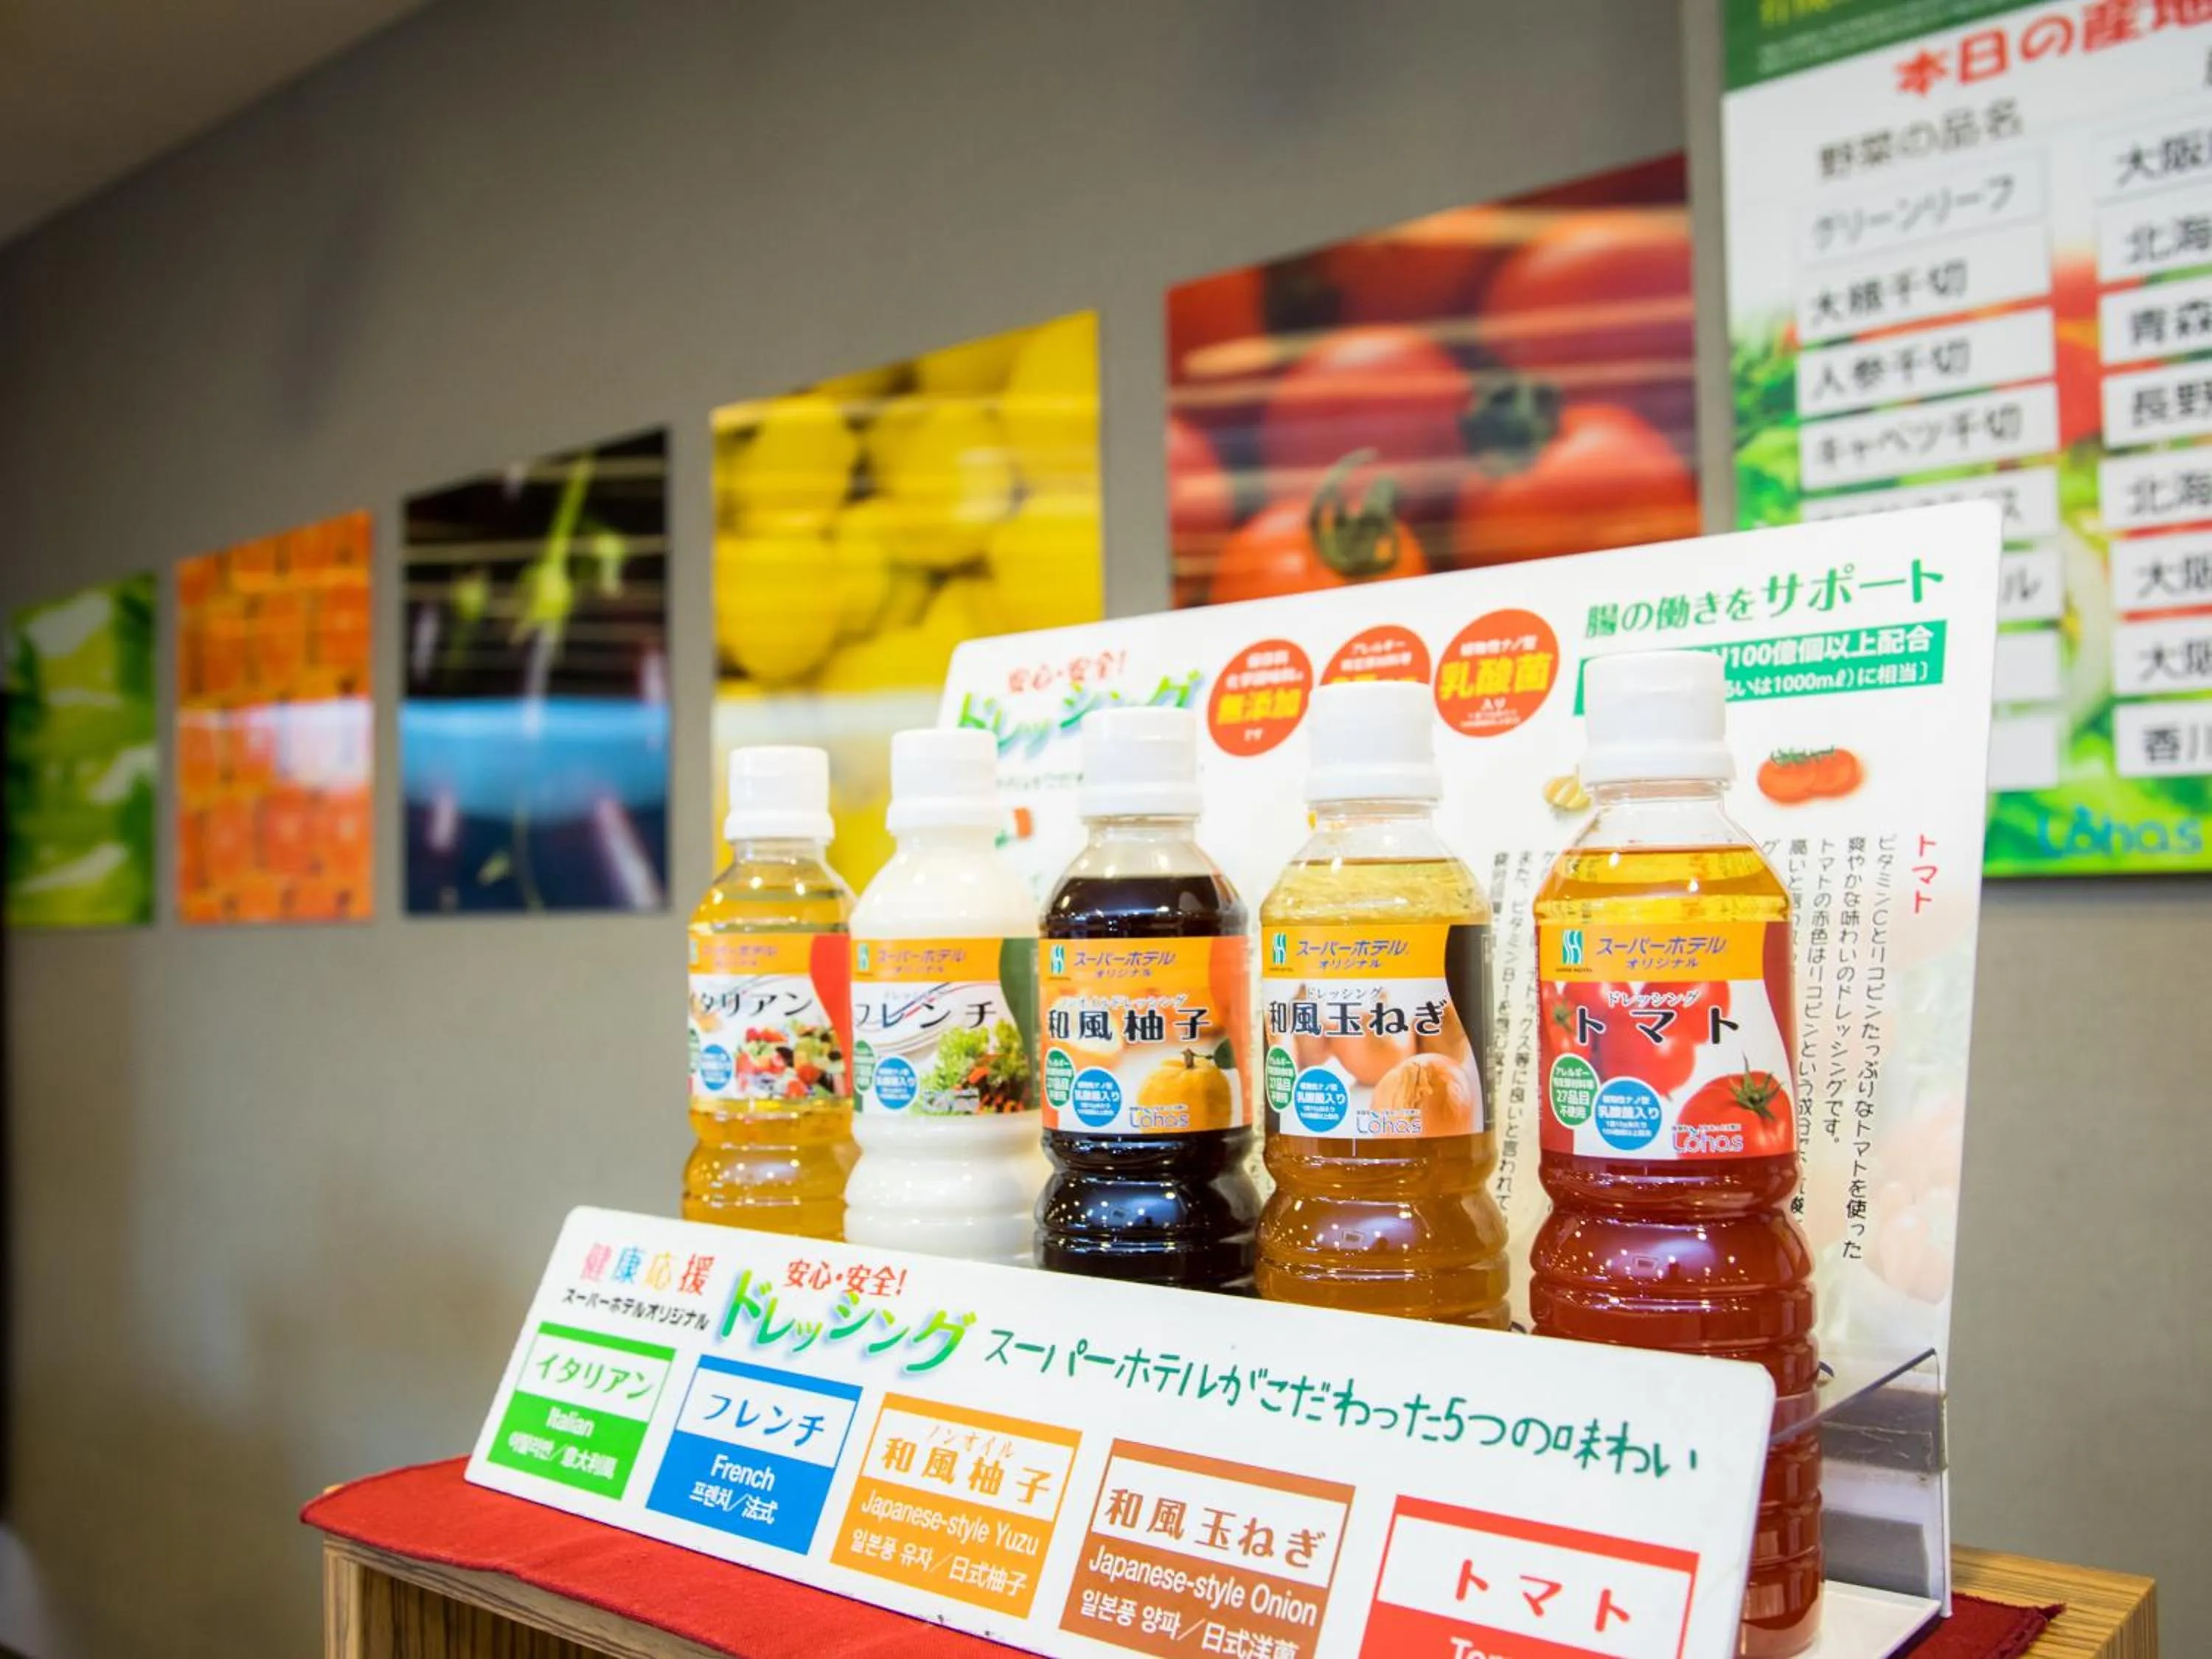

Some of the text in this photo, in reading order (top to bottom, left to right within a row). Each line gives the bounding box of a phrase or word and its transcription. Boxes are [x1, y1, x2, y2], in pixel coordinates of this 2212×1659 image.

[1818, 99, 2023, 181] 野菜の品名
[2115, 127, 2212, 187] 大阪
[1585, 558, 1944, 639] 腸の働きをサポート
[1911, 834, 1938, 914] トマト
[1074, 950, 1176, 967] スーパーホテル
[1296, 940, 1407, 957] スーパーホテル
[1596, 935, 1727, 956] スーパーホテル
[1626, 958, 1699, 970] オリジナル
[855, 1001, 996, 1029] フレンチ
[1269, 998, 1447, 1036] 和風玉ねぎ
[1607, 990, 1699, 1009] ドレッシング
[1048, 1008, 1210, 1042] 和風柚子
[1578, 1006, 1739, 1045] トマト
[581, 1242, 714, 1296] 健康応援
[787, 1258, 908, 1297] 安心・安全!
[561, 1288, 710, 1331] スーパーホテルオリジナル
[720, 1269, 978, 1371] ドレッシング
[537, 1352, 655, 1399] イタリアン
[703, 1393, 826, 1447] フレンチ
[984, 1327, 1698, 1480] スーパーホテルがこだわった5つの味わい
[710, 1453, 776, 1492] French
[882, 1436, 1053, 1505] 和風柚子
[850, 1528, 897, 1562] 일본풍
[861, 1489, 1040, 1556] Japanese-style Yuzu
[1105, 1486, 1326, 1571] 和風玉ねぎ
[1079, 1589, 1138, 1627] 일본풍
[1088, 1544, 1318, 1627] Japanese-style Onion
[1455, 1558, 1631, 1632] トマト
